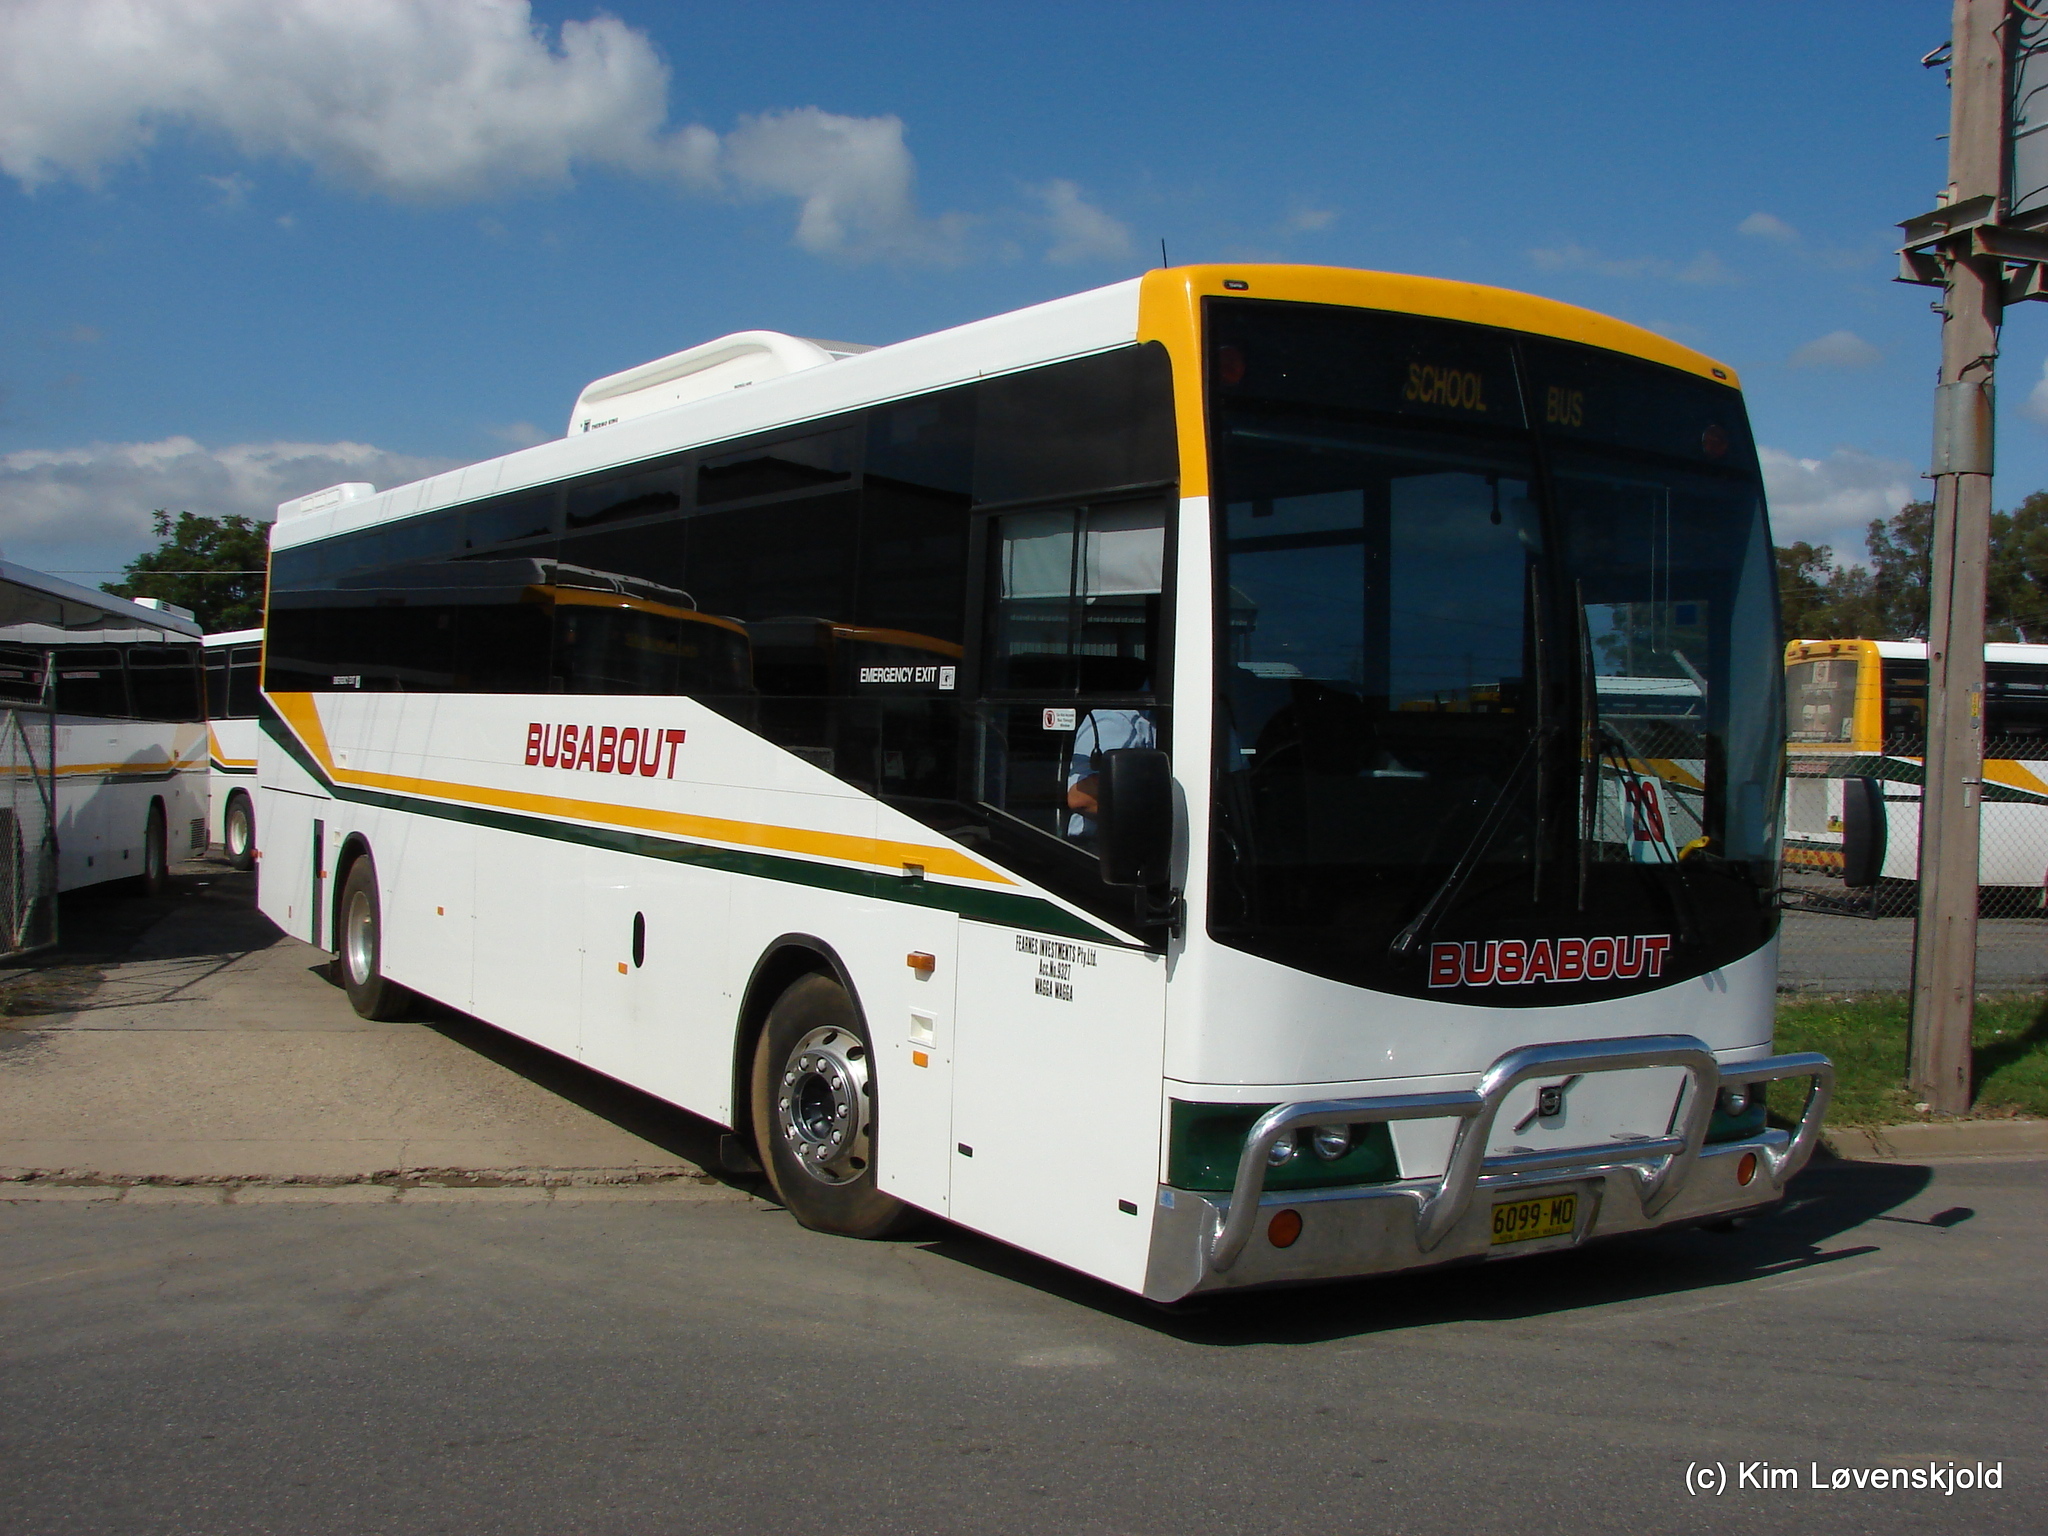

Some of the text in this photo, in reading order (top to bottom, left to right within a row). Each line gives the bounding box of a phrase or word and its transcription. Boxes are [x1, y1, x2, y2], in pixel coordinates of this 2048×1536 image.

[1405, 362, 1584, 428] SCHOOL BUS
[860, 666, 937, 682] EMERGENCY EXIT
[525, 723, 686, 779] BUSABOUT
[1015, 934, 1039, 955] FEARNES
[1039, 939, 1076, 962] INVESTMENTS
[1428, 934, 1670, 988] BUSABOUT
[1034, 977, 1073, 1002] WAGGA WAGGA
